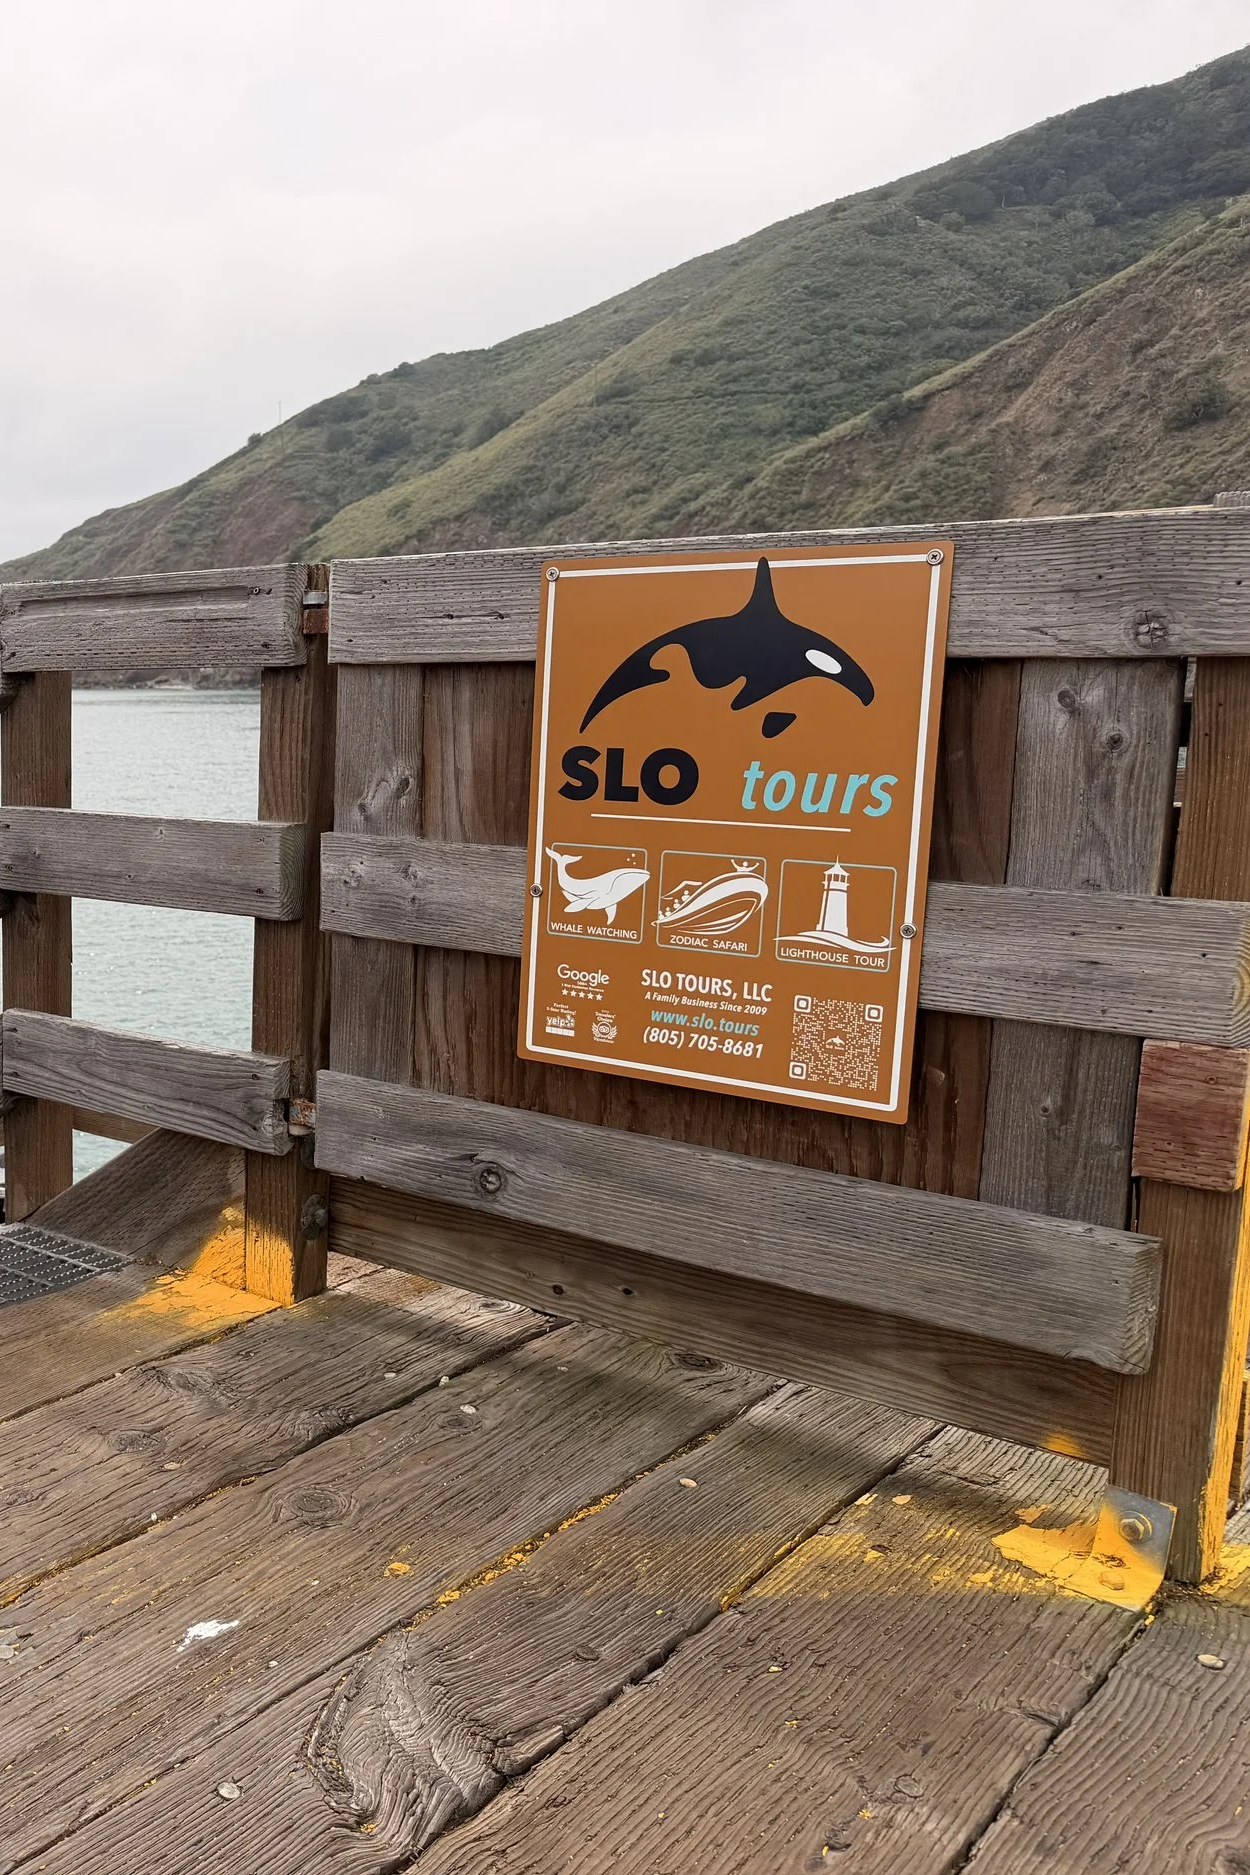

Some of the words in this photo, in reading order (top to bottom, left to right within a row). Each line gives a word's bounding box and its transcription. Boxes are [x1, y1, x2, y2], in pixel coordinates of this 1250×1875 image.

[557, 745, 700, 806] SLO
[740, 760, 899, 818] tours
[550, 922, 583, 934] WHALE
[587, 926, 638, 939] WATCHING
[669, 935, 709, 948] ZODIAC
[712, 939, 748, 952] SAFARI
[780, 947, 850, 963] LIGHTHOUSE
[853, 955, 885, 968] TOUR
[557, 963, 610, 987] Google
[641, 969, 672, 989] SLO
[676, 973, 738, 1000] TOURS,
[742, 981, 773, 1002] LLC
[644, 991, 651, 1000] A
[652, 992, 680, 1006] Family
[681, 996, 718, 1009] Business
[719, 1001, 743, 1012] Since
[743, 1005, 768, 1016] 2009
[651, 1010, 760, 1036] www.slo.tours
[643, 1026, 685, 1049] (805)
[688, 1033, 764, 1059] 705-8681
